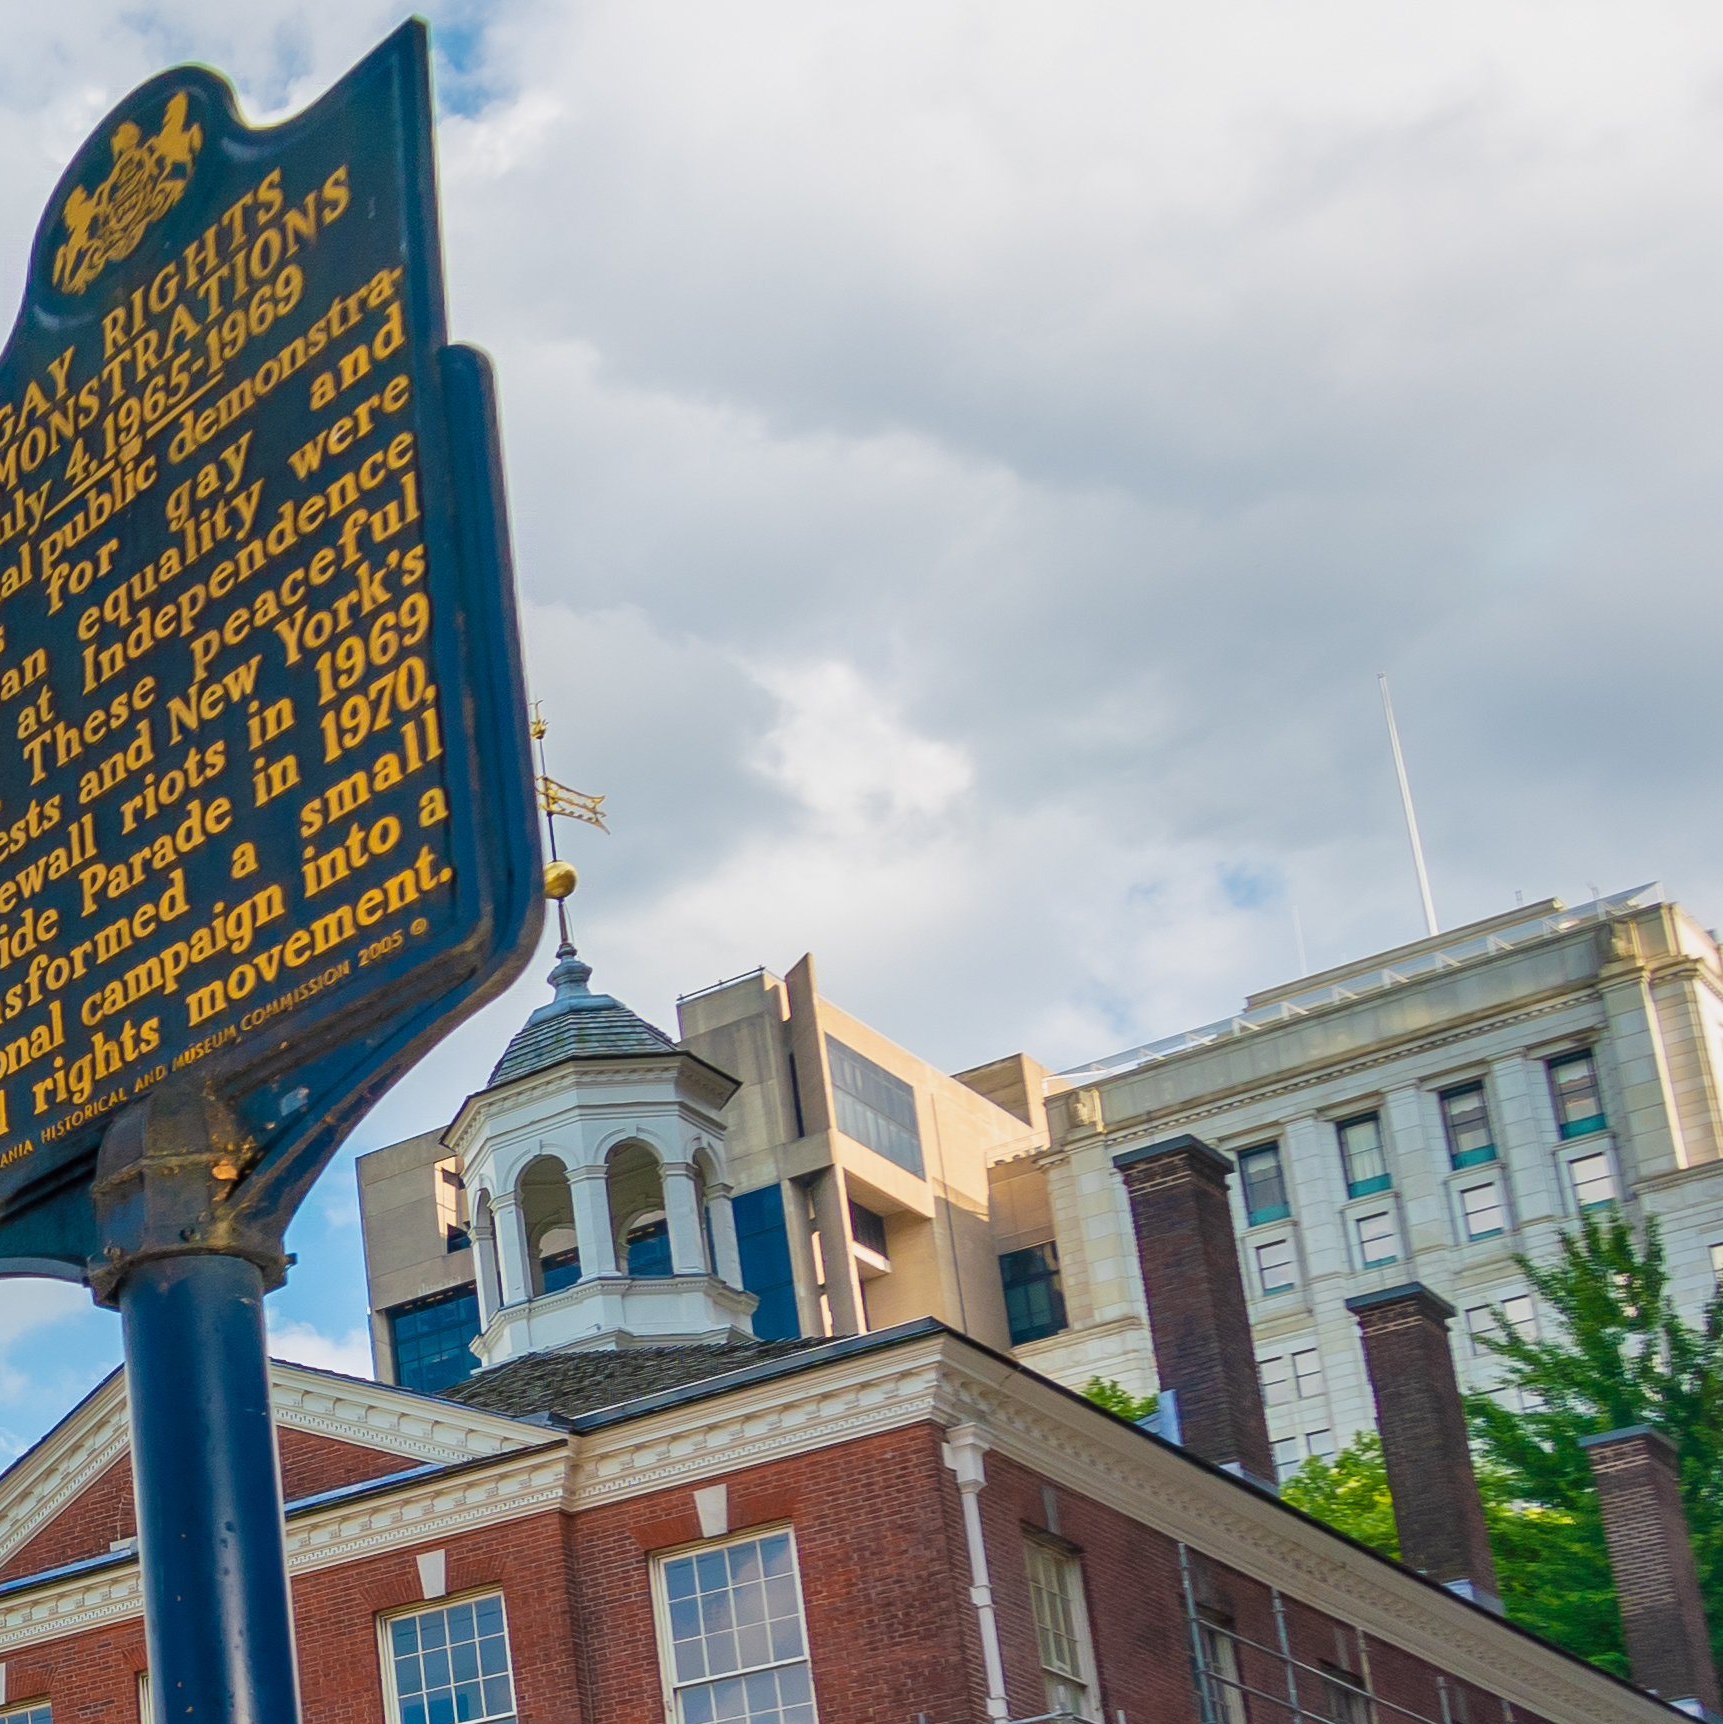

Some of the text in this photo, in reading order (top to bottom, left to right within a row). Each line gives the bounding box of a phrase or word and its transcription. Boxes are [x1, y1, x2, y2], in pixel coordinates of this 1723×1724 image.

[64, 437, 98, 487] 4,
[103, 263, 303, 462] 1965-1969
[101, 166, 284, 360] RIGHTS
[38, 454, 157, 581] public
[167, 265, 405, 465] demonstra-
[45, 537, 120, 616] for
[164, 429, 253, 533] gay
[309, 300, 405, 412] and
[76, 477, 265, 642] equality
[287, 373, 410, 482] were
[16, 683, 55, 740] at
[81, 430, 415, 696] Independence
[23, 675, 156, 786] These
[189, 470, 421, 682] peaceful
[78, 717, 155, 804] and
[166, 654, 263, 747] New
[273, 543, 425, 667] York's
[120, 739, 226, 835] riots
[246, 697, 296, 752] in
[314, 591, 429, 706] 1969
[78, 796, 233, 918] Parade
[252, 753, 301, 809] in
[319, 655, 437, 764] 1970,
[81, 883, 285, 1026] campaign
[302, 815, 402, 898] into
[418, 786, 449, 828] a
[230, 841, 258, 880] a
[300, 706, 443, 839] small
[31, 1016, 160, 1115] rights
[185, 844, 453, 1028] movement.
[41, 1087, 127, 1144] HISTORICAL
[134, 1063, 167, 1093] AND
[172, 1024, 238, 1071] MUSEUM
[240, 959, 350, 1031] COMMISSION
[358, 929, 403, 967] 2005
